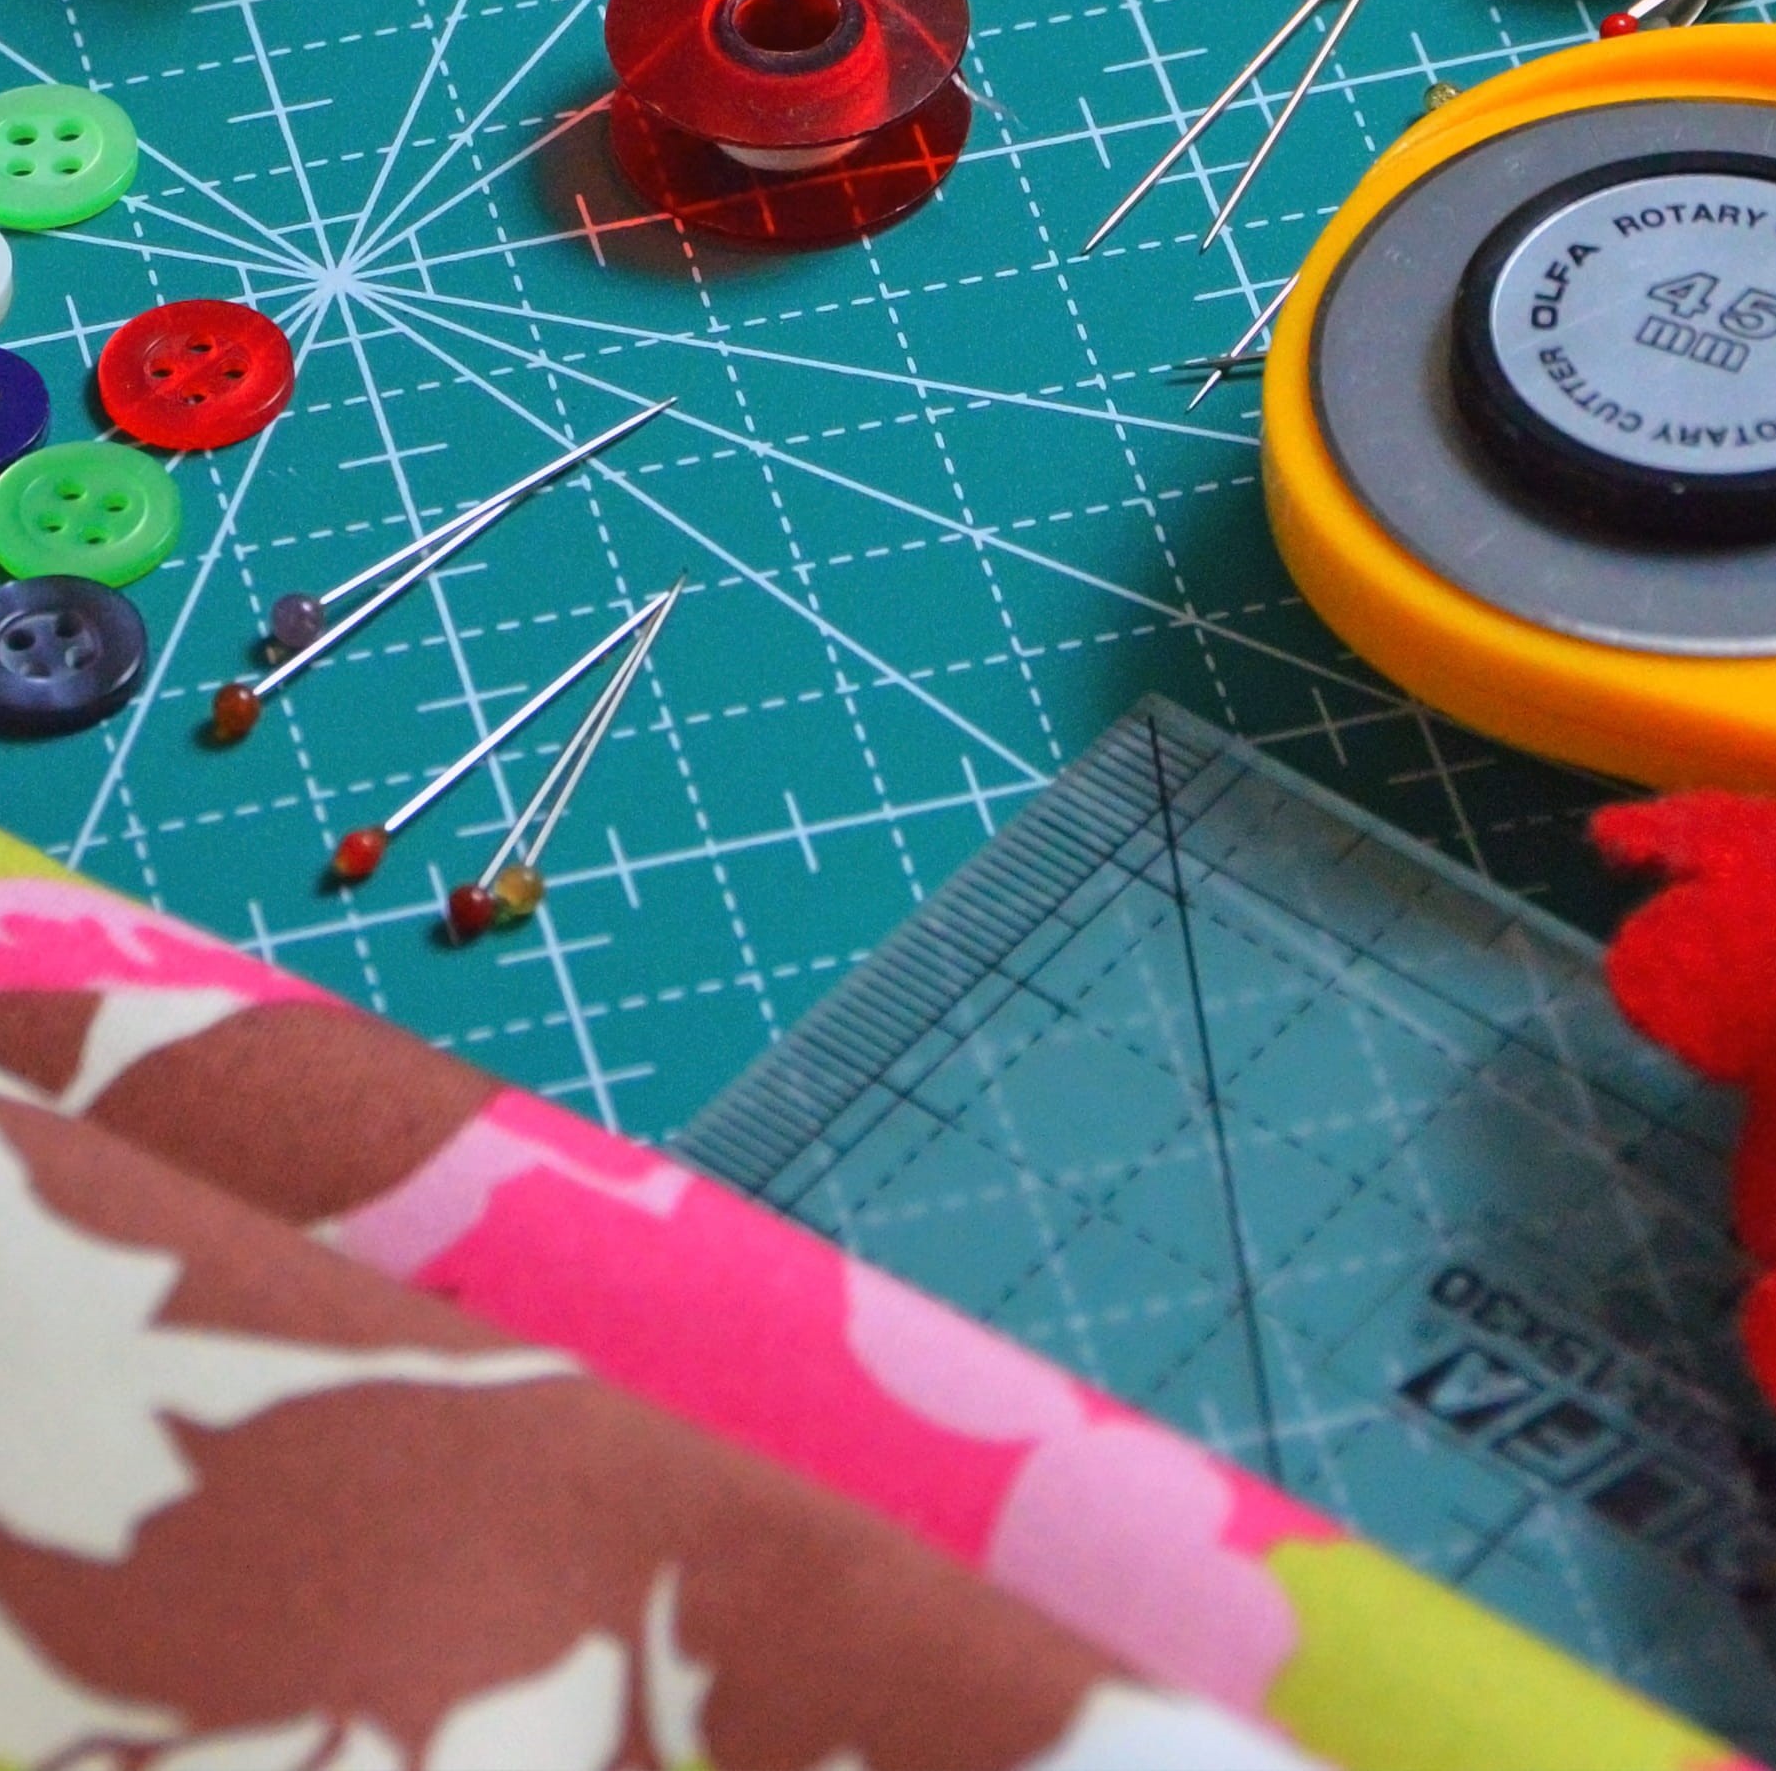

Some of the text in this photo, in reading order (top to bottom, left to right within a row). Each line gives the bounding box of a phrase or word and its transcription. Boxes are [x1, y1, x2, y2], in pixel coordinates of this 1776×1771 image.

[1612, 203, 1768, 238] ROTARY
[1531, 241, 1602, 330] OLFA
[1635, 315, 1751, 374] mm
[1538, 345, 1645, 433] CUTTER
